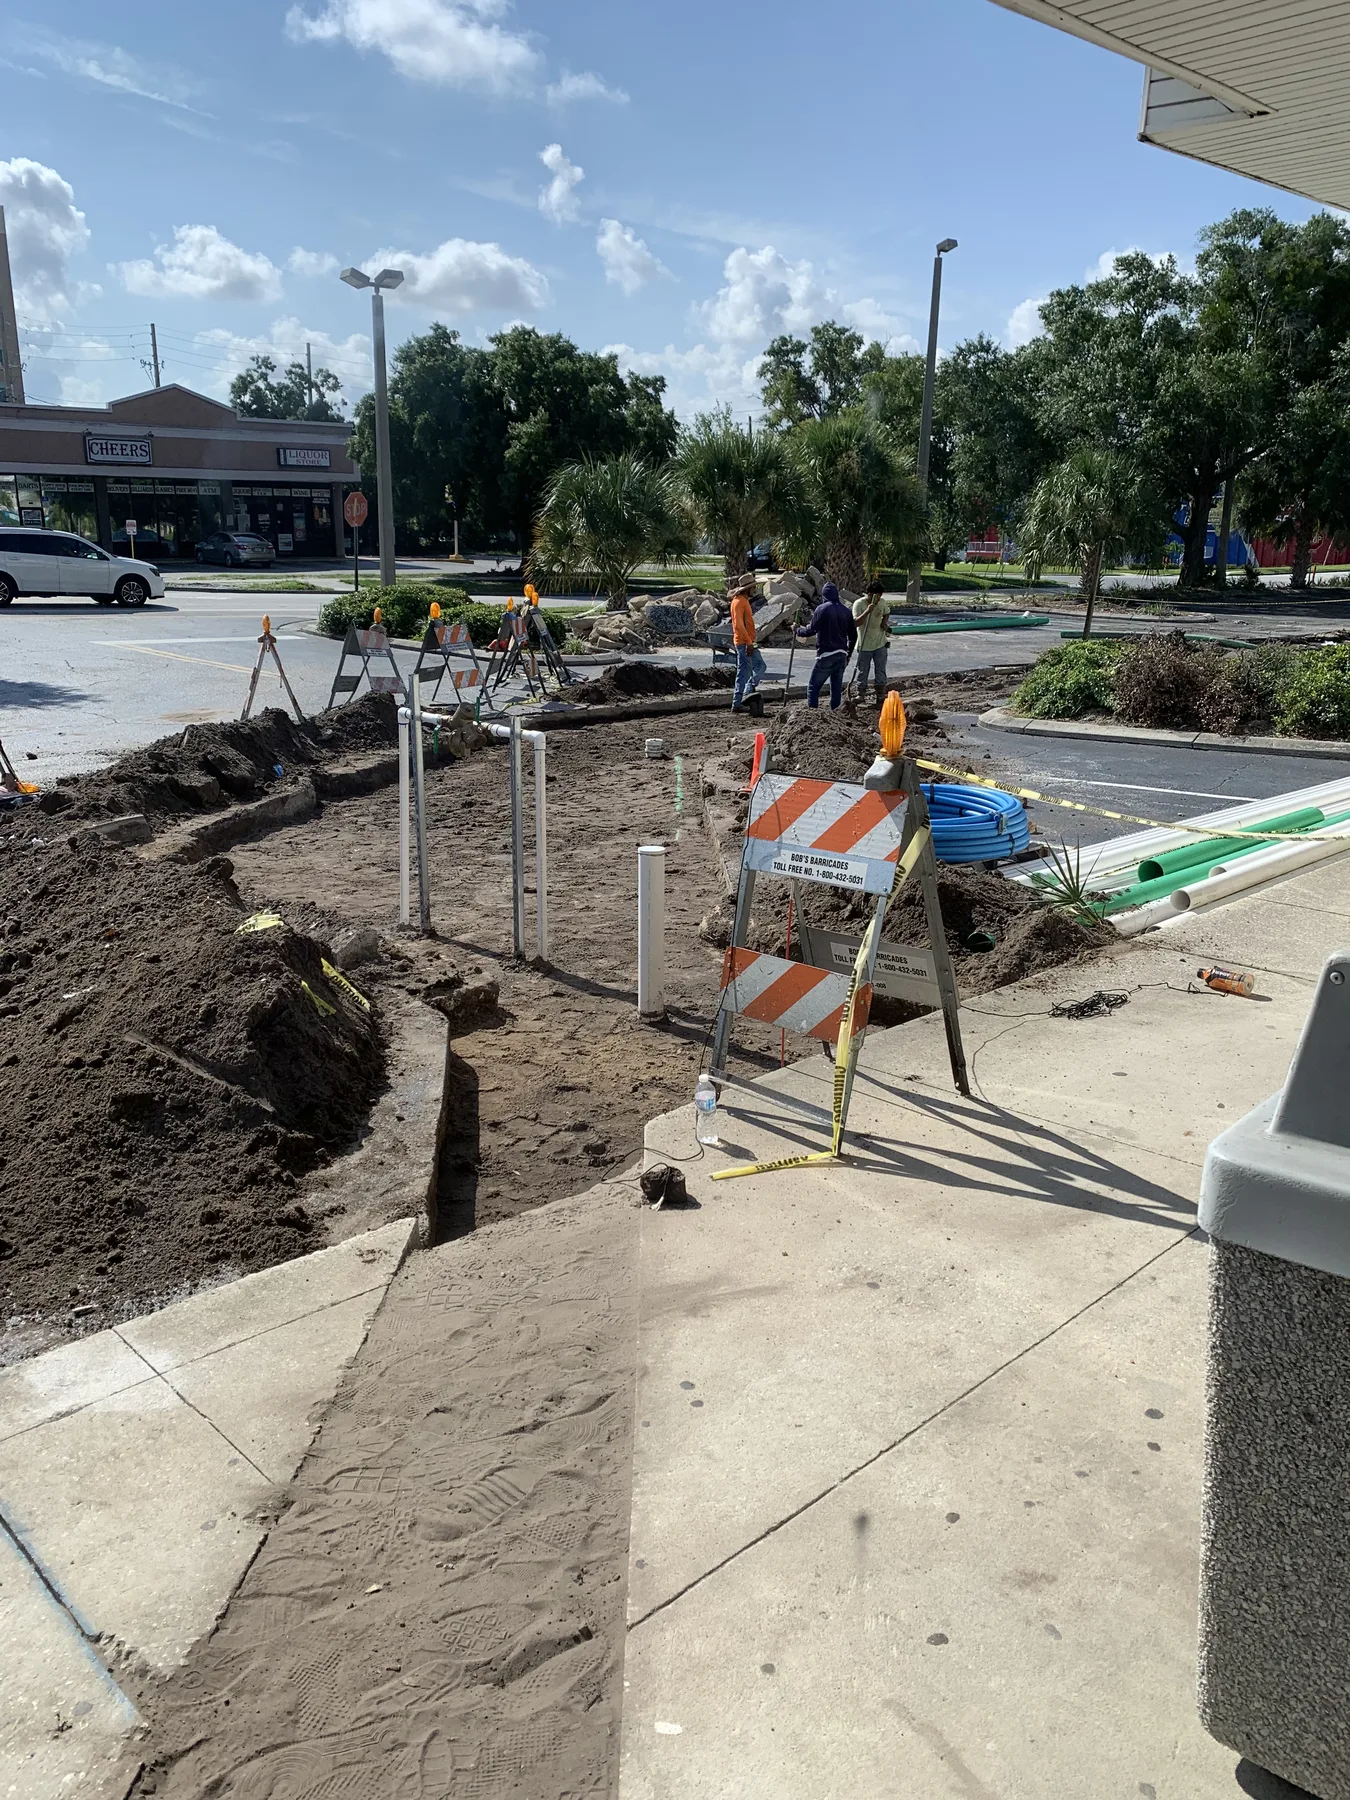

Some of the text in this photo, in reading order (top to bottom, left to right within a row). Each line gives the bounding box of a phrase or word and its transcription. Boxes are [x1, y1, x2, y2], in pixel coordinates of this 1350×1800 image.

[90, 441, 149, 457] CHEERS
[289, 450, 328, 460] LIQUOR
[18, 482, 39, 490] DARTS
[346, 502, 366, 517] STOP
[790, 853, 849, 871] BOB'S BARRICADES
[773, 861, 864, 885] TOLL FREE NO. 1-800-432-5031
[833, 953, 848, 963] TOLL
[876, 952, 908, 965] RRICADES
[878, 962, 928, 977] 1-800-432-5031
[331, 974, 367, 1007] CAUTION
[832, 1065, 848, 1124] CUIDADO
